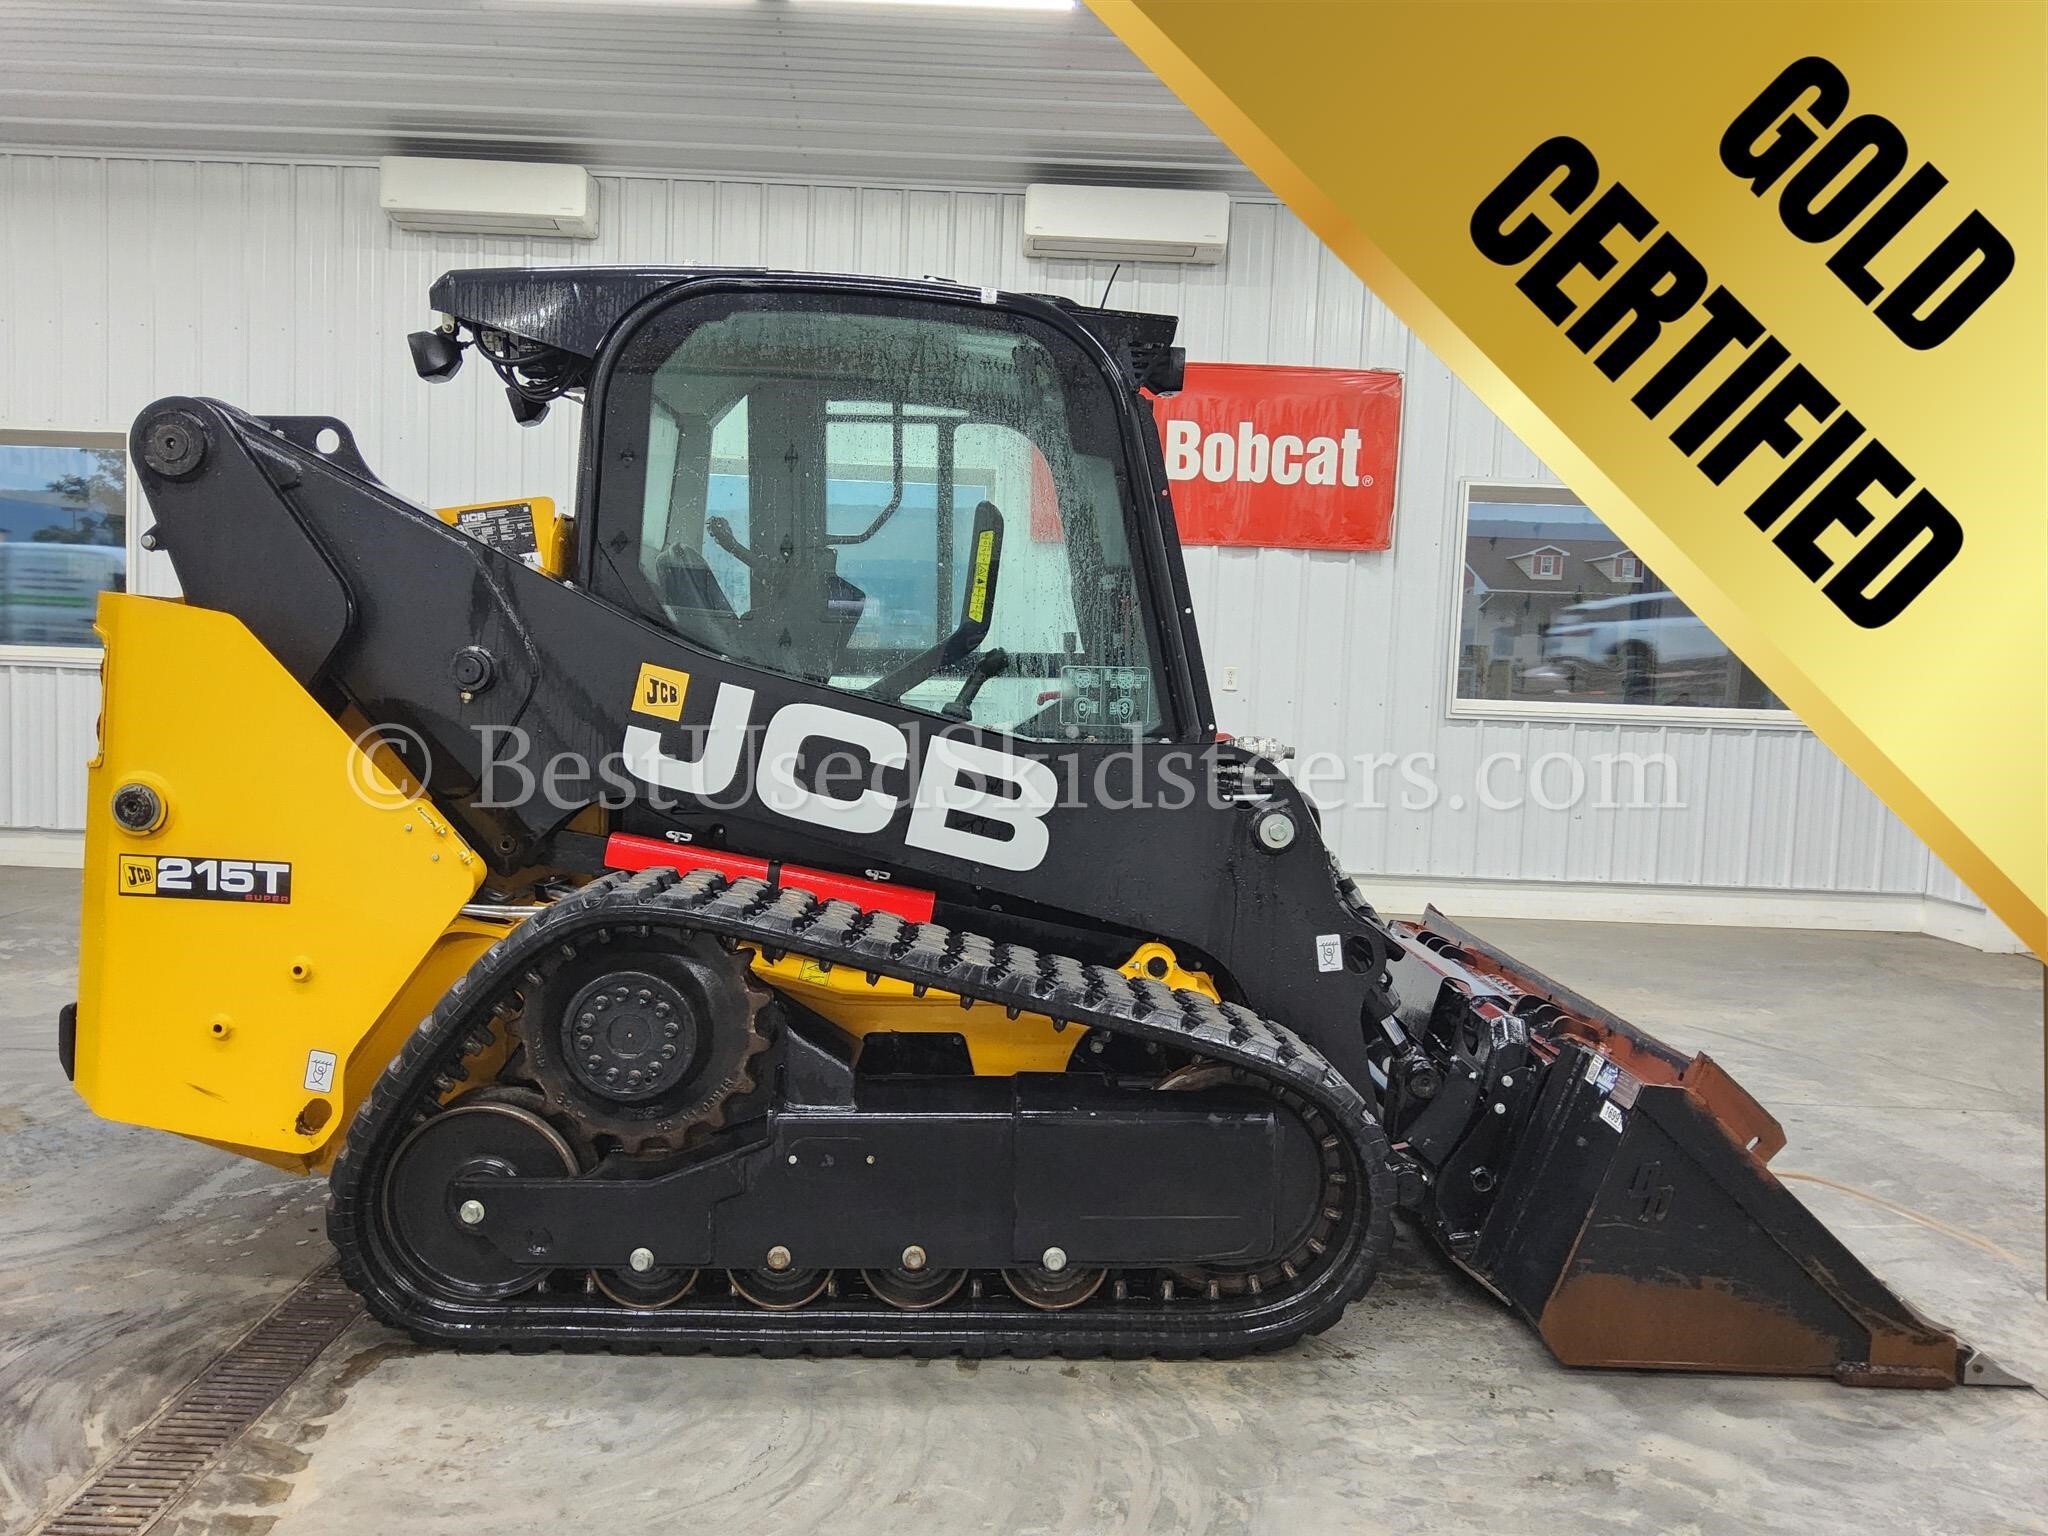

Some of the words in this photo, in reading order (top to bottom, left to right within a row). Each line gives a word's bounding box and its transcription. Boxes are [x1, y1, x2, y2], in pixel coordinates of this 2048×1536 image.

[1166, 420, 1362, 487] Bobcat
[461, 512, 487, 523] JCB
[646, 678, 678, 704] JCB
[623, 682, 1058, 871] JCB
[128, 865, 152, 886] JCB
[157, 857, 290, 895] 215T
[245, 894, 289, 903] SUPER
